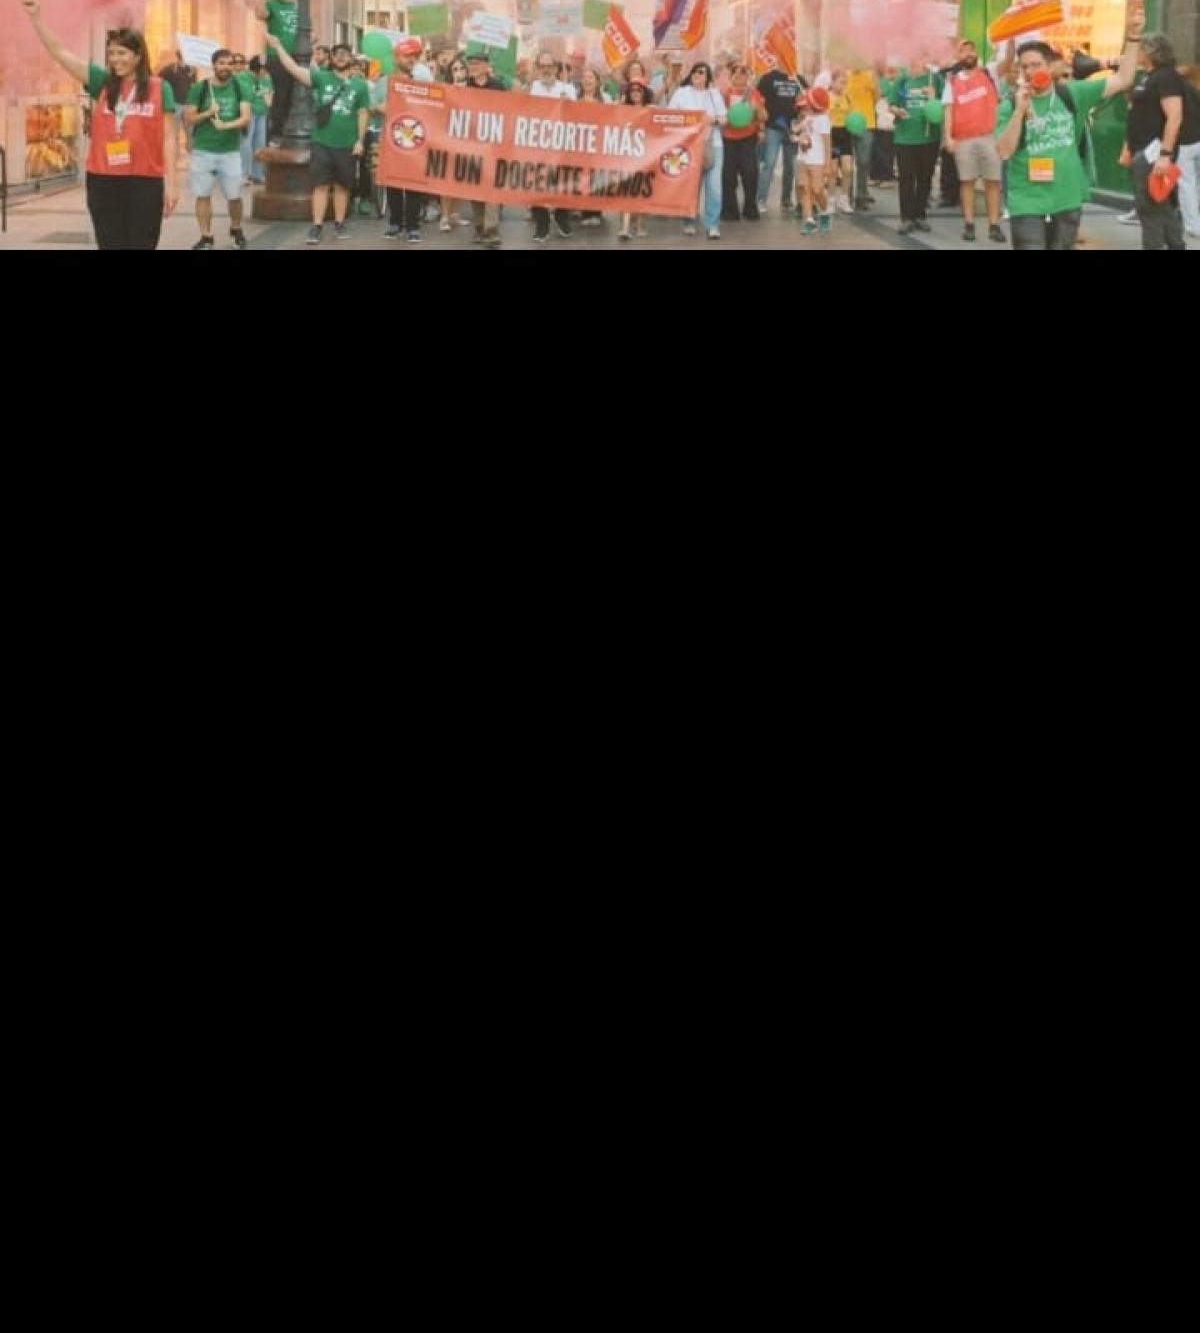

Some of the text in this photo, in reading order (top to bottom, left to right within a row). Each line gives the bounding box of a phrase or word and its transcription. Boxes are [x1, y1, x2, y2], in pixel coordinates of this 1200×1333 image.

[449, 107, 646, 157] NI UN RECORTE MÁS
[425, 148, 655, 198] NI UN DOCENTE MENOS
